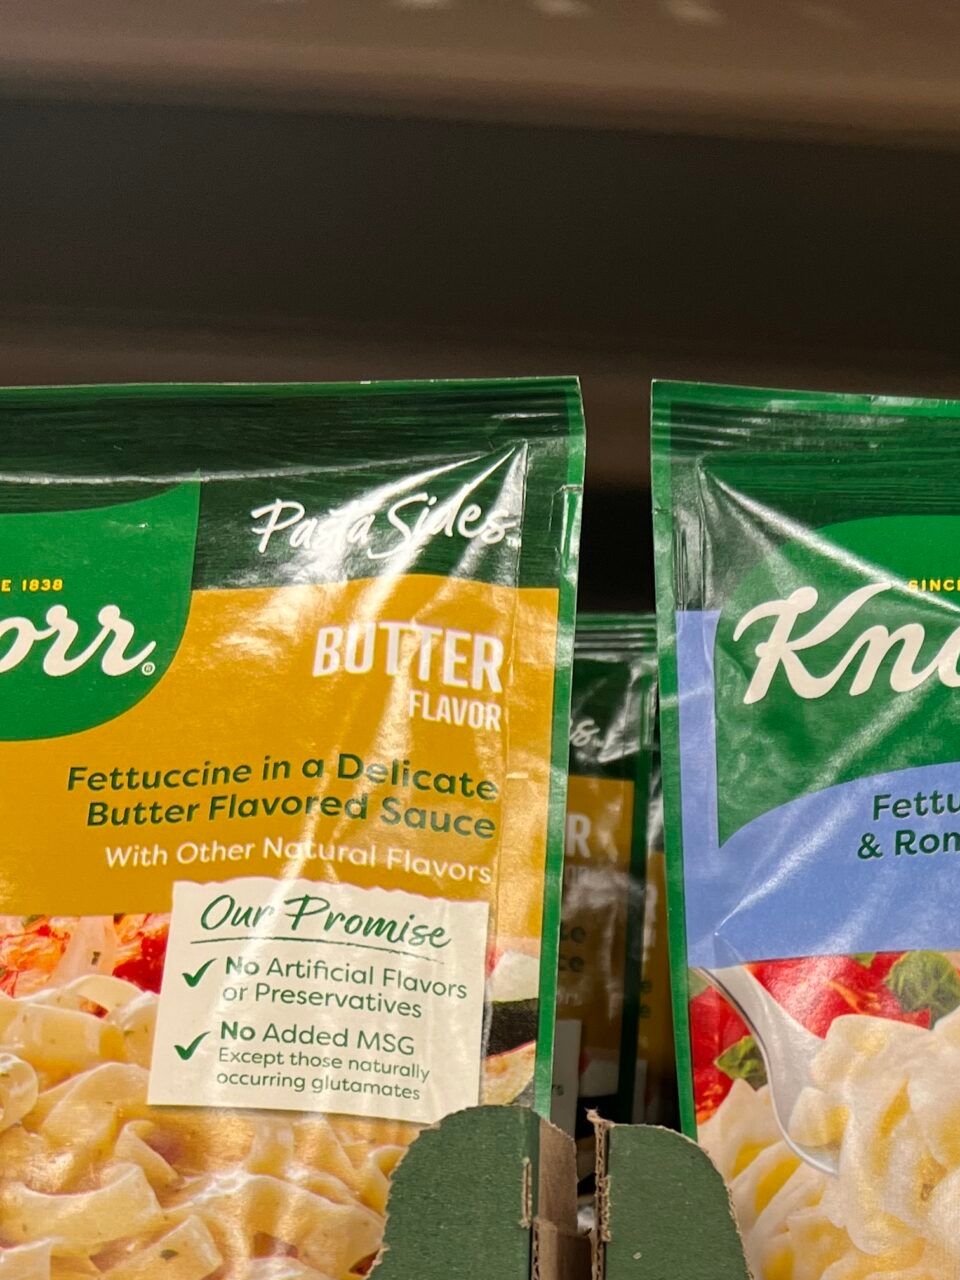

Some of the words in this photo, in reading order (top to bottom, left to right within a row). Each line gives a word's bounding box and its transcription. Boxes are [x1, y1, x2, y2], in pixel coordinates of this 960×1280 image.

[251, 498, 377, 554] Pasta
[368, 490, 517, 559] Sides
[21, 578, 63, 592] 1838
[312, 619, 505, 693] BUTTER
[408, 689, 502, 731] FLAVOR
[67, 760, 251, 792] Fettuccine
[262, 756, 291, 781] in
[301, 759, 326, 780] a
[337, 752, 499, 802] Delicate
[87, 800, 200, 828] Butter
[208, 793, 369, 822] Flavored
[380, 797, 498, 840] Sauce
[105, 843, 168, 868] With
[175, 840, 255, 865] Other
[262, 836, 377, 869] Natural
[386, 846, 494, 884] Flavors
[857, 832, 884, 860] &
[199, 894, 275, 930] Our
[284, 894, 452, 949] Promise
[225, 956, 260, 977] No
[266, 957, 374, 986] Artificial
[382, 967, 468, 999] Flavors
[222, 984, 248, 1001] or
[255, 982, 423, 1018] Preservatives
[220, 1020, 256, 1042] No
[262, 1022, 349, 1048] Added
[357, 1029, 416, 1056] MSG
[216, 1071, 307, 1093] occurring
[310, 1075, 421, 1101] glutamates
[218, 1047, 285, 1069] Except
[289, 1049, 343, 1070] those
[347, 1056, 431, 1083] naturally
